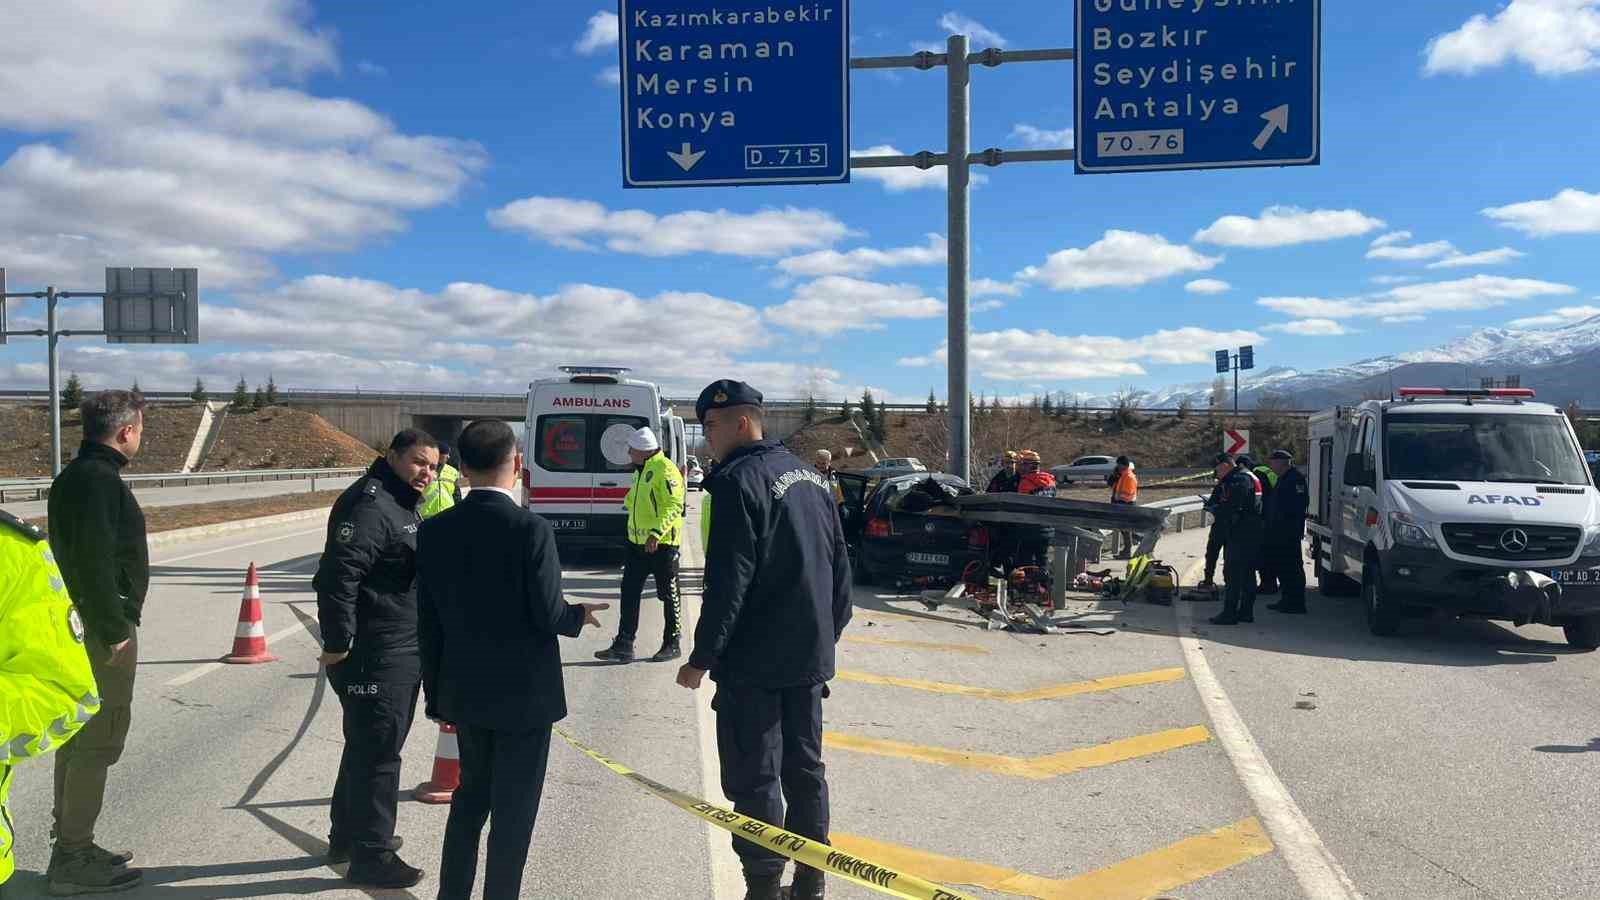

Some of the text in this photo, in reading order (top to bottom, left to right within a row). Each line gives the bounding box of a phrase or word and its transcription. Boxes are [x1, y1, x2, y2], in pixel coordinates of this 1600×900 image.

[634, 4, 833, 27] Kazımkarabekir
[1093, 25, 1208, 50] Bozkır
[635, 39, 794, 61] Karaman
[636, 72, 753, 95] Mersin
[1093, 55, 1297, 89] Seydişehir
[1094, 93, 1239, 121] Antalya
[637, 107, 736, 133] Konya
[1103, 134, 1179, 152] 70.76
[750, 148, 822, 165] D.715
[552, 397, 632, 409] AMBULANS
[770, 468, 832, 500] JANDARMA
[1467, 494, 1541, 506] AFAD
[770, 832, 806, 852] OLAY
[825, 850, 898, 888] JANDARMA
